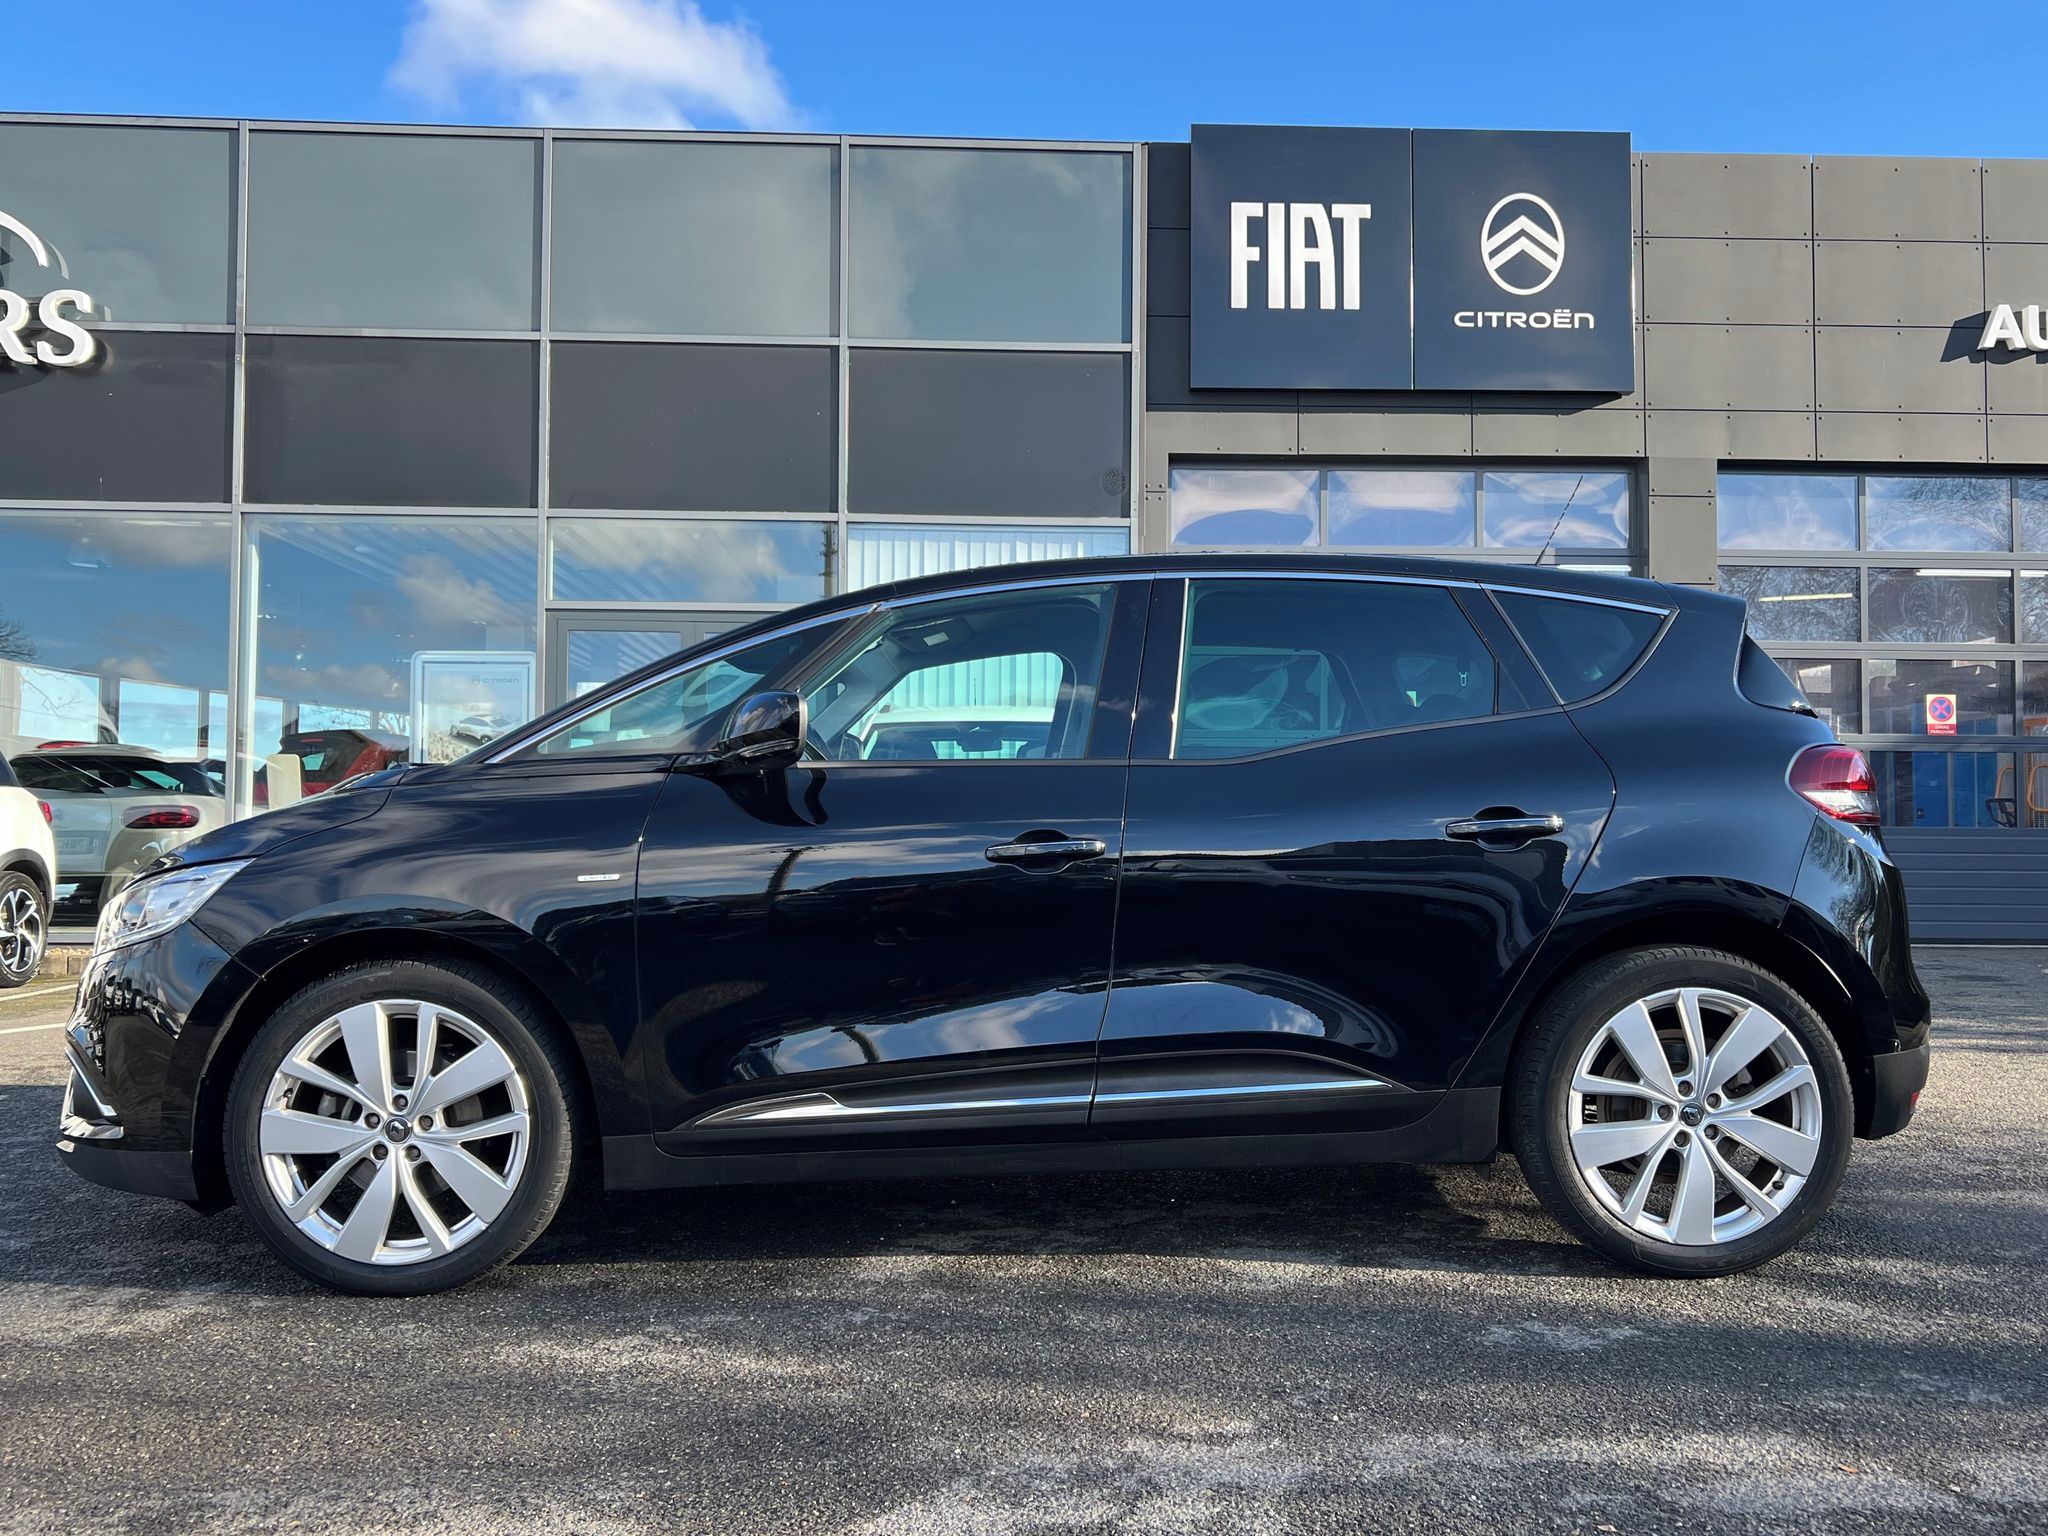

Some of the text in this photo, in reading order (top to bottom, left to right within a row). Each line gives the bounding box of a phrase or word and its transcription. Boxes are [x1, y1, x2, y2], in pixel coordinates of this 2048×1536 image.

[1231, 202, 1371, 310] FIAT
[1453, 309, 1594, 329] CITROËN
[1977, 304, 2048, 352] AU
